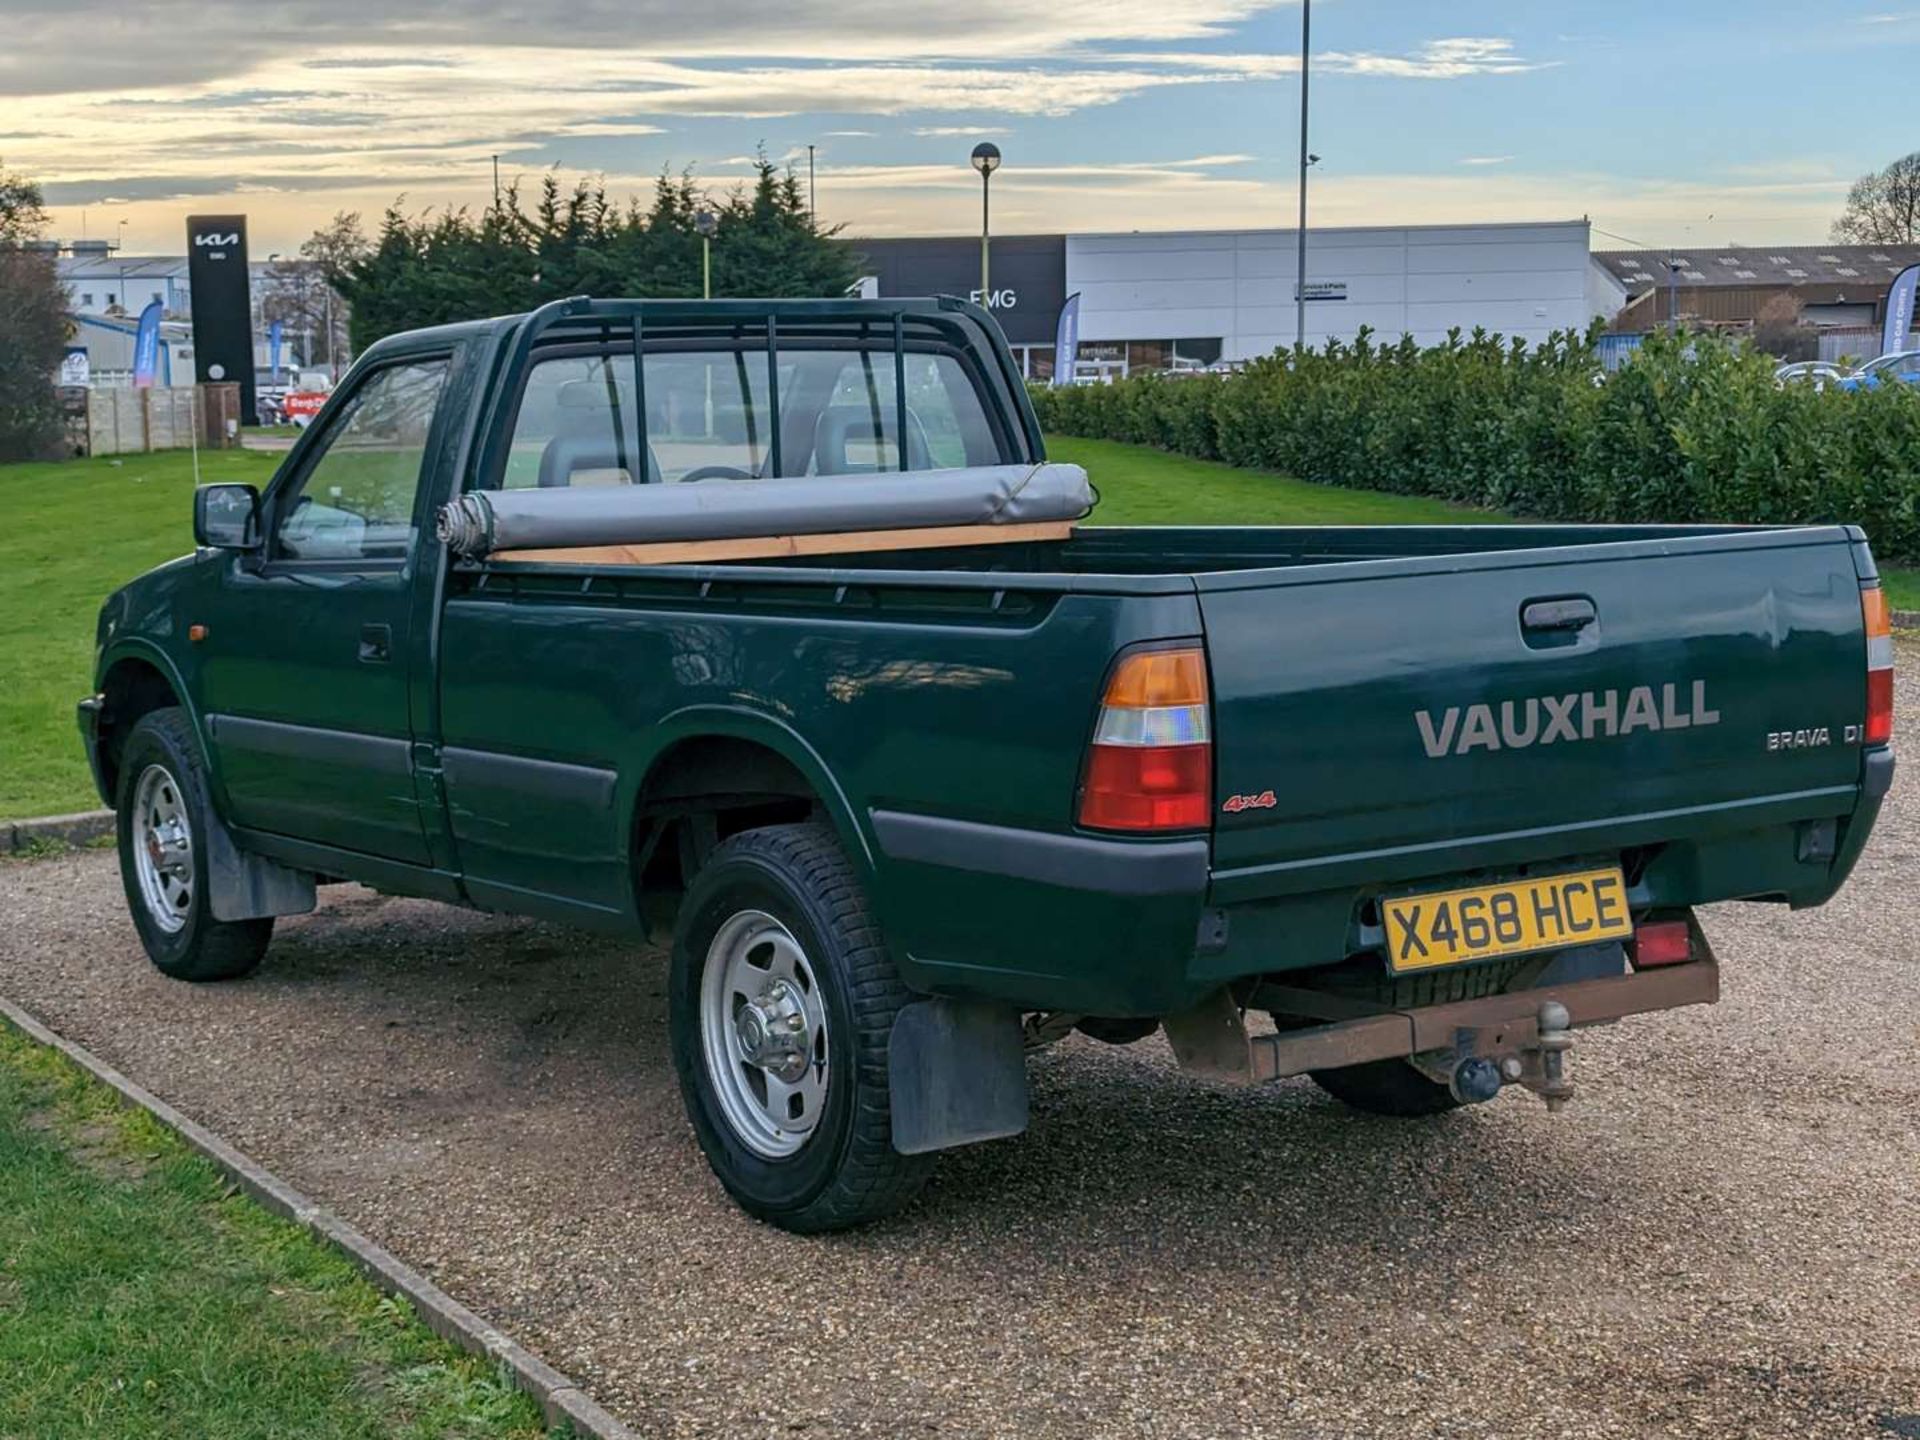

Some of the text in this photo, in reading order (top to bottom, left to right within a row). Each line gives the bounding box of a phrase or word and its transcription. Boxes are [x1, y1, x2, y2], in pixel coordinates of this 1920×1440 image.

[195, 233, 239, 246] KIA
[1415, 679, 1720, 758] VAUXHALL
[1767, 727, 1832, 749] BRAVA
[1223, 790, 1277, 812] 4x4
[1393, 877, 1625, 960] X468 HCE
